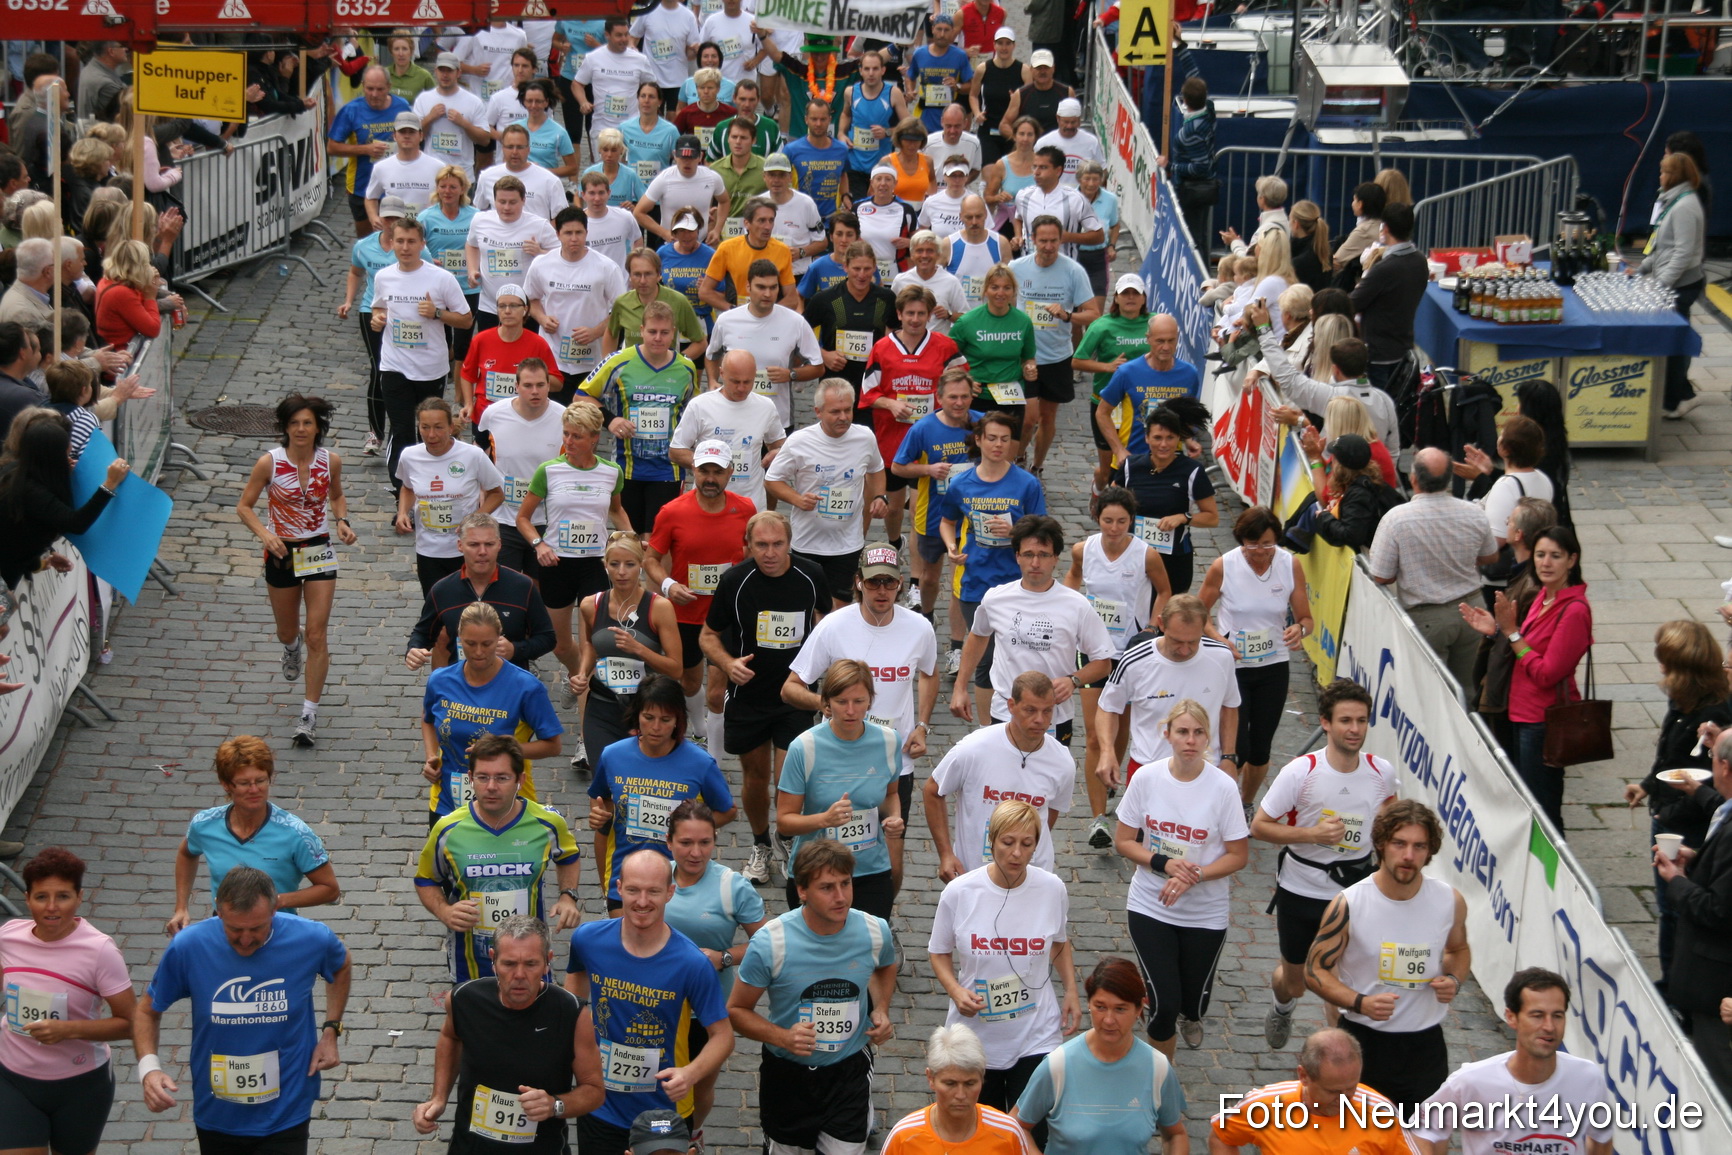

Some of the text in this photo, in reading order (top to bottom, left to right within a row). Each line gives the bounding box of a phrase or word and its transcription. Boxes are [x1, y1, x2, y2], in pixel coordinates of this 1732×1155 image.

[336, 0, 390, 15] 6352
[757, 0, 928, 40] DANKE NEUMARKT
[1130, 7, 1160, 47] A
[143, 62, 238, 84] Schnupper-
[175, 85, 206, 100] lauf
[934, 91, 948, 99] 771
[612, 104, 628, 112] 2357
[440, 139, 459, 147] 2352
[728, 227, 743, 235] 897
[1037, 313, 1053, 322] 669
[402, 331, 423, 340] 2351
[976, 330, 1022, 343] Sinupret
[570, 348, 591, 356] 2360
[849, 343, 867, 352] 765
[754, 381, 772, 390] 764
[1568, 360, 1649, 399] Glossner
[1004, 389, 1018, 397] 445
[1610, 382, 1646, 398] Bier
[632, 393, 677, 403] BOCK
[641, 419, 665, 428] 3183
[831, 501, 854, 510] 2277
[972, 497, 1019, 506] NEUMARKTER
[438, 513, 452, 523] 55
[571, 523, 586, 531] Anita
[571, 534, 599, 544] 2072
[1145, 530, 1170, 543] 2133
[307, 550, 334, 563] 1052
[775, 626, 796, 637] 621
[1249, 640, 1273, 653] 2309
[611, 669, 641, 681] 3036
[441, 699, 508, 719] 10. NEUMARKTER
[446, 709, 495, 725] STADTLAUF
[614, 776, 689, 793] 10. NEUMARKTER
[622, 785, 675, 798] STADTLAUF
[642, 800, 672, 811] Christine
[841, 823, 871, 838] 2331
[1145, 814, 1208, 842] kago
[1162, 842, 1183, 856] Daniela
[466, 863, 533, 878] BOCK
[485, 896, 500, 906] Roy
[970, 934, 1045, 955] kago
[1398, 947, 1431, 957] Wolfgang
[1407, 961, 1425, 974] 96
[591, 973, 676, 1000] 10. NEUMARKTER
[990, 980, 1010, 991] Karin
[255, 989, 286, 1002] FÜRTH
[601, 986, 660, 1008] STADTLAUF
[812, 988, 851, 997] NUNNER
[994, 989, 1029, 1008] 2375
[255, 1001, 286, 1012] 1860
[816, 1006, 841, 1016] Stefan
[211, 1014, 288, 1026] Marathonteam
[816, 1020, 852, 1034] 3359
[613, 1048, 645, 1062] Andreas
[228, 1060, 250, 1070] Hans
[612, 1062, 651, 1078] 2737
[236, 1072, 267, 1089] 951
[491, 1093, 515, 1107] Klaus
[494, 1110, 527, 1128] 915
